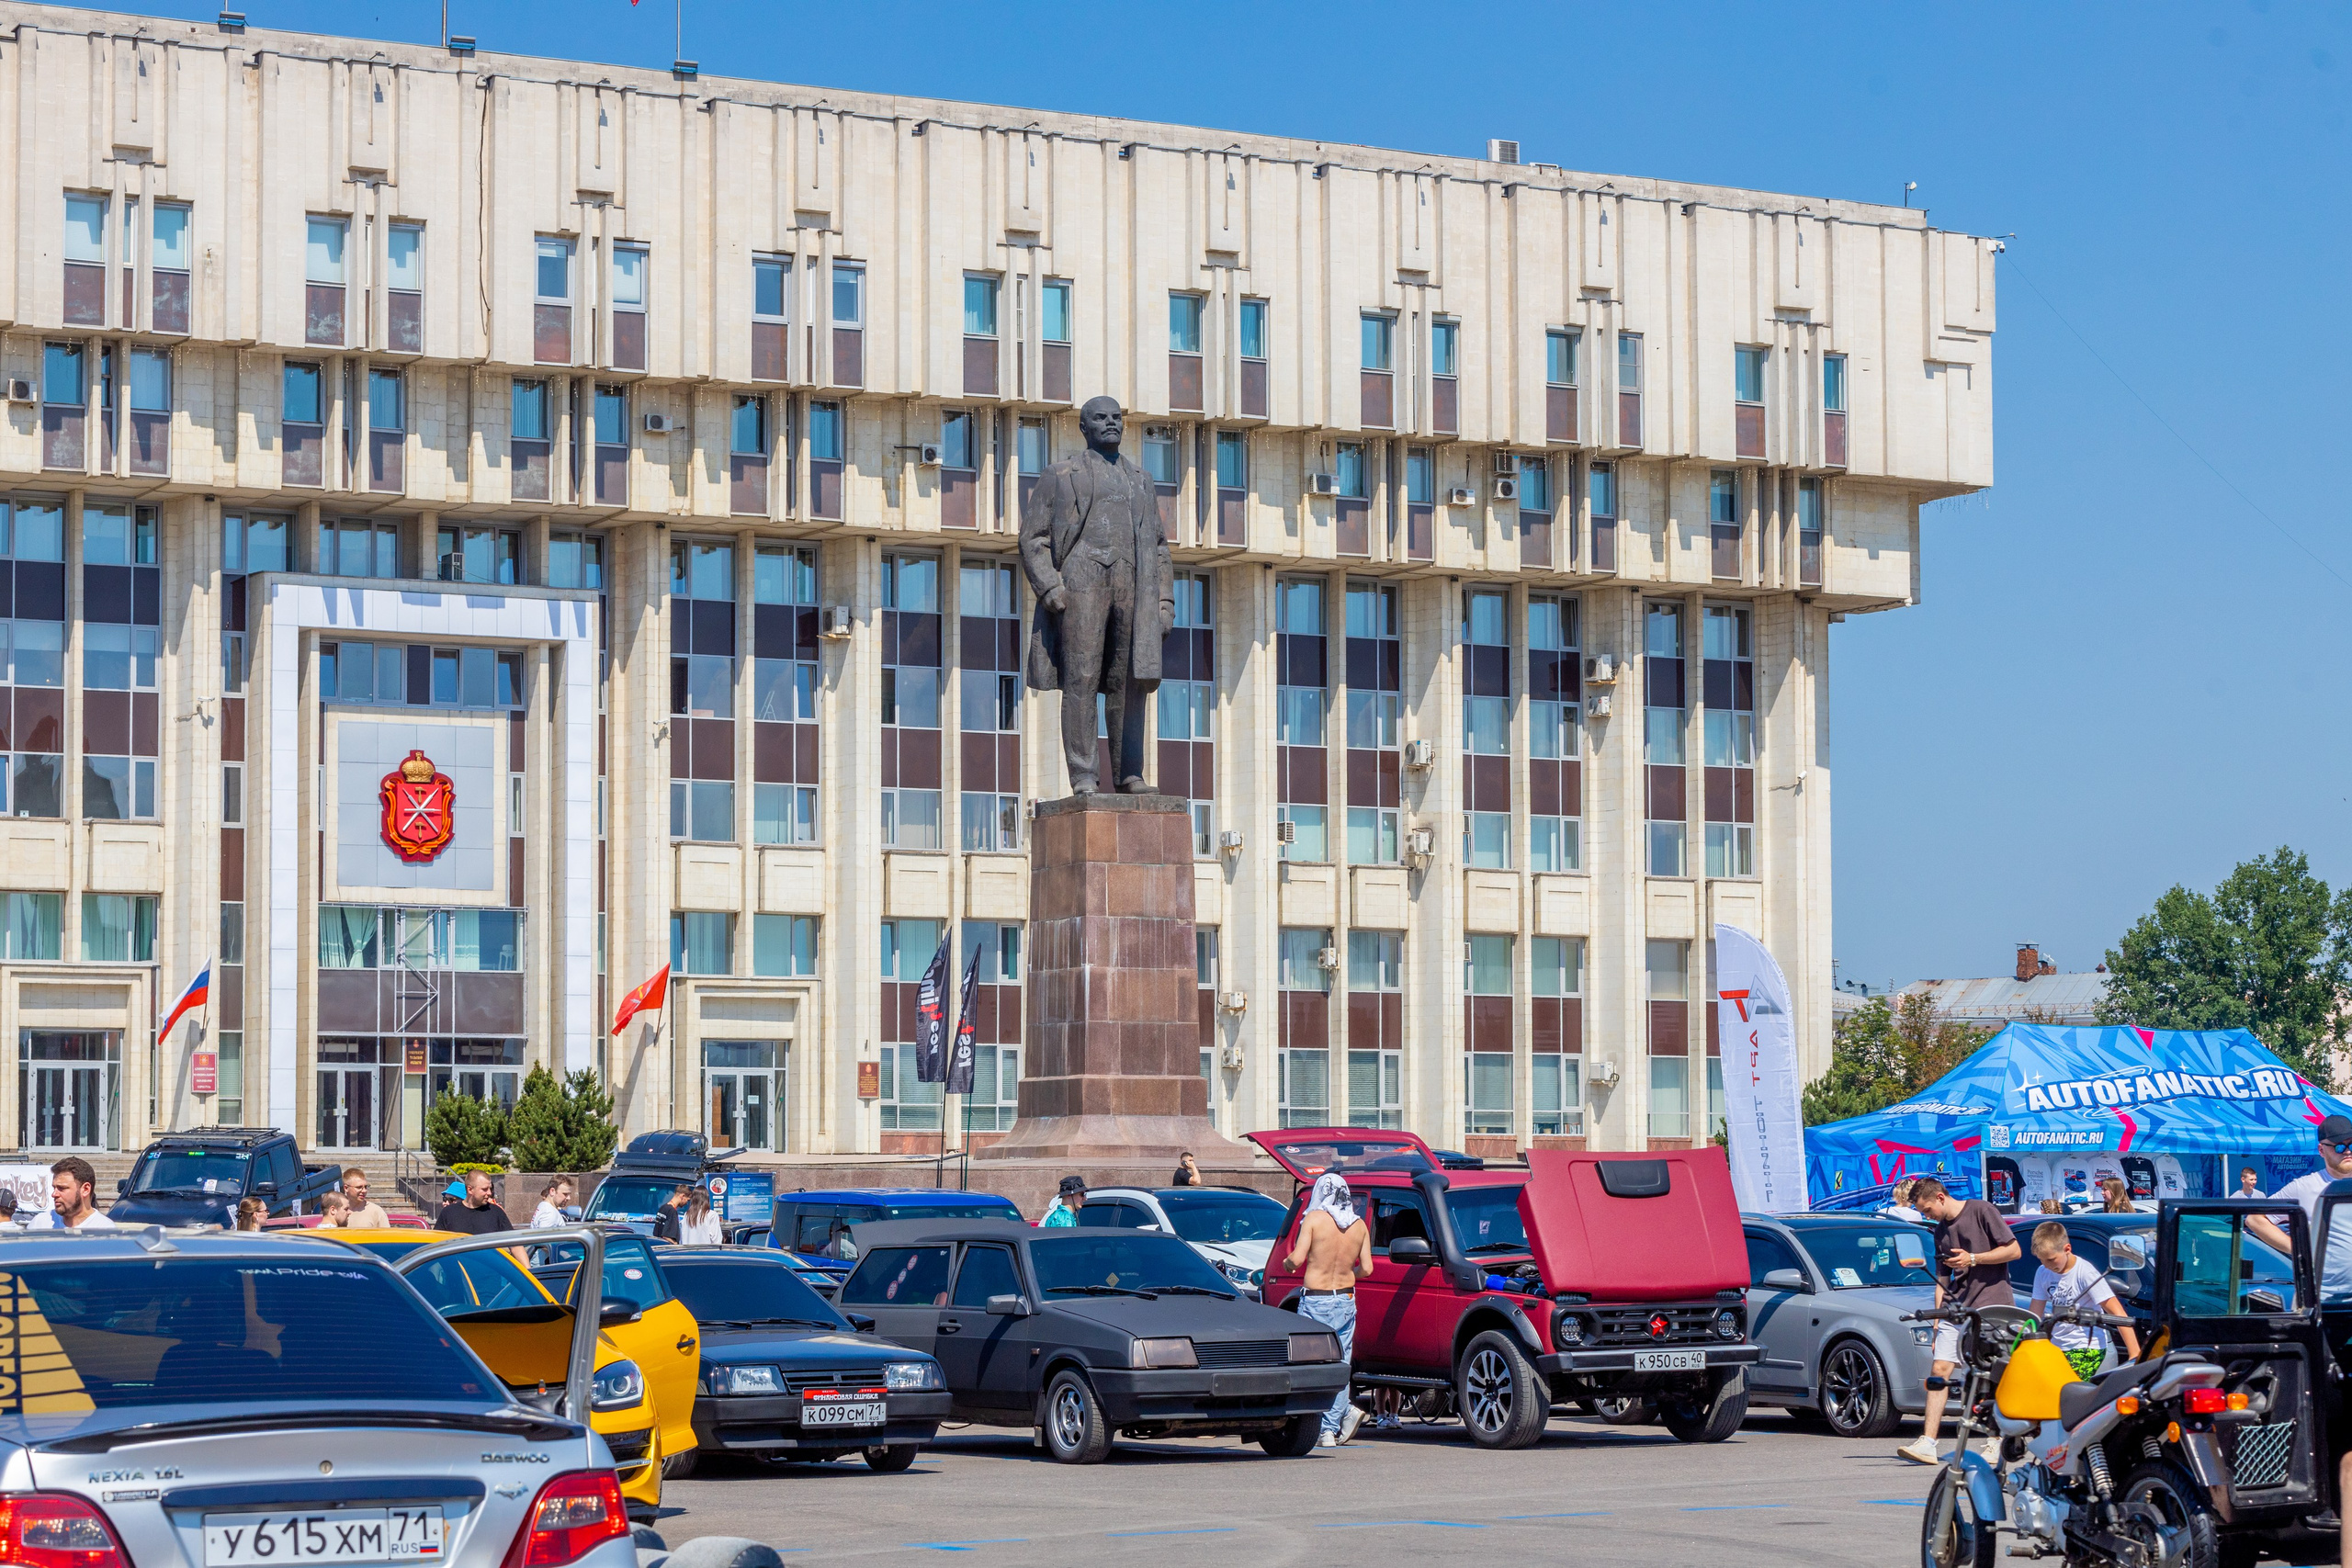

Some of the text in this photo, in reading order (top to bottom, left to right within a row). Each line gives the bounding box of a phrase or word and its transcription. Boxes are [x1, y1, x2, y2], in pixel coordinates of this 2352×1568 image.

[2028, 1069, 2301, 1111] AUTOFANATIC.RU
[2015, 1132, 2104, 1145] AUTOFANATIC.RU
[2272, 1156, 2302, 1164] МАГАЗИН
[0, 1174, 49, 1209] nkey
[1690, 1352, 1702, 1363] 40
[868, 1404, 881, 1416] 71
[481, 1451, 550, 1463] DAEWOO
[88, 1468, 145, 1484] NEXIA
[392, 1511, 428, 1541] 71
[390, 1542, 419, 1554] RUS
